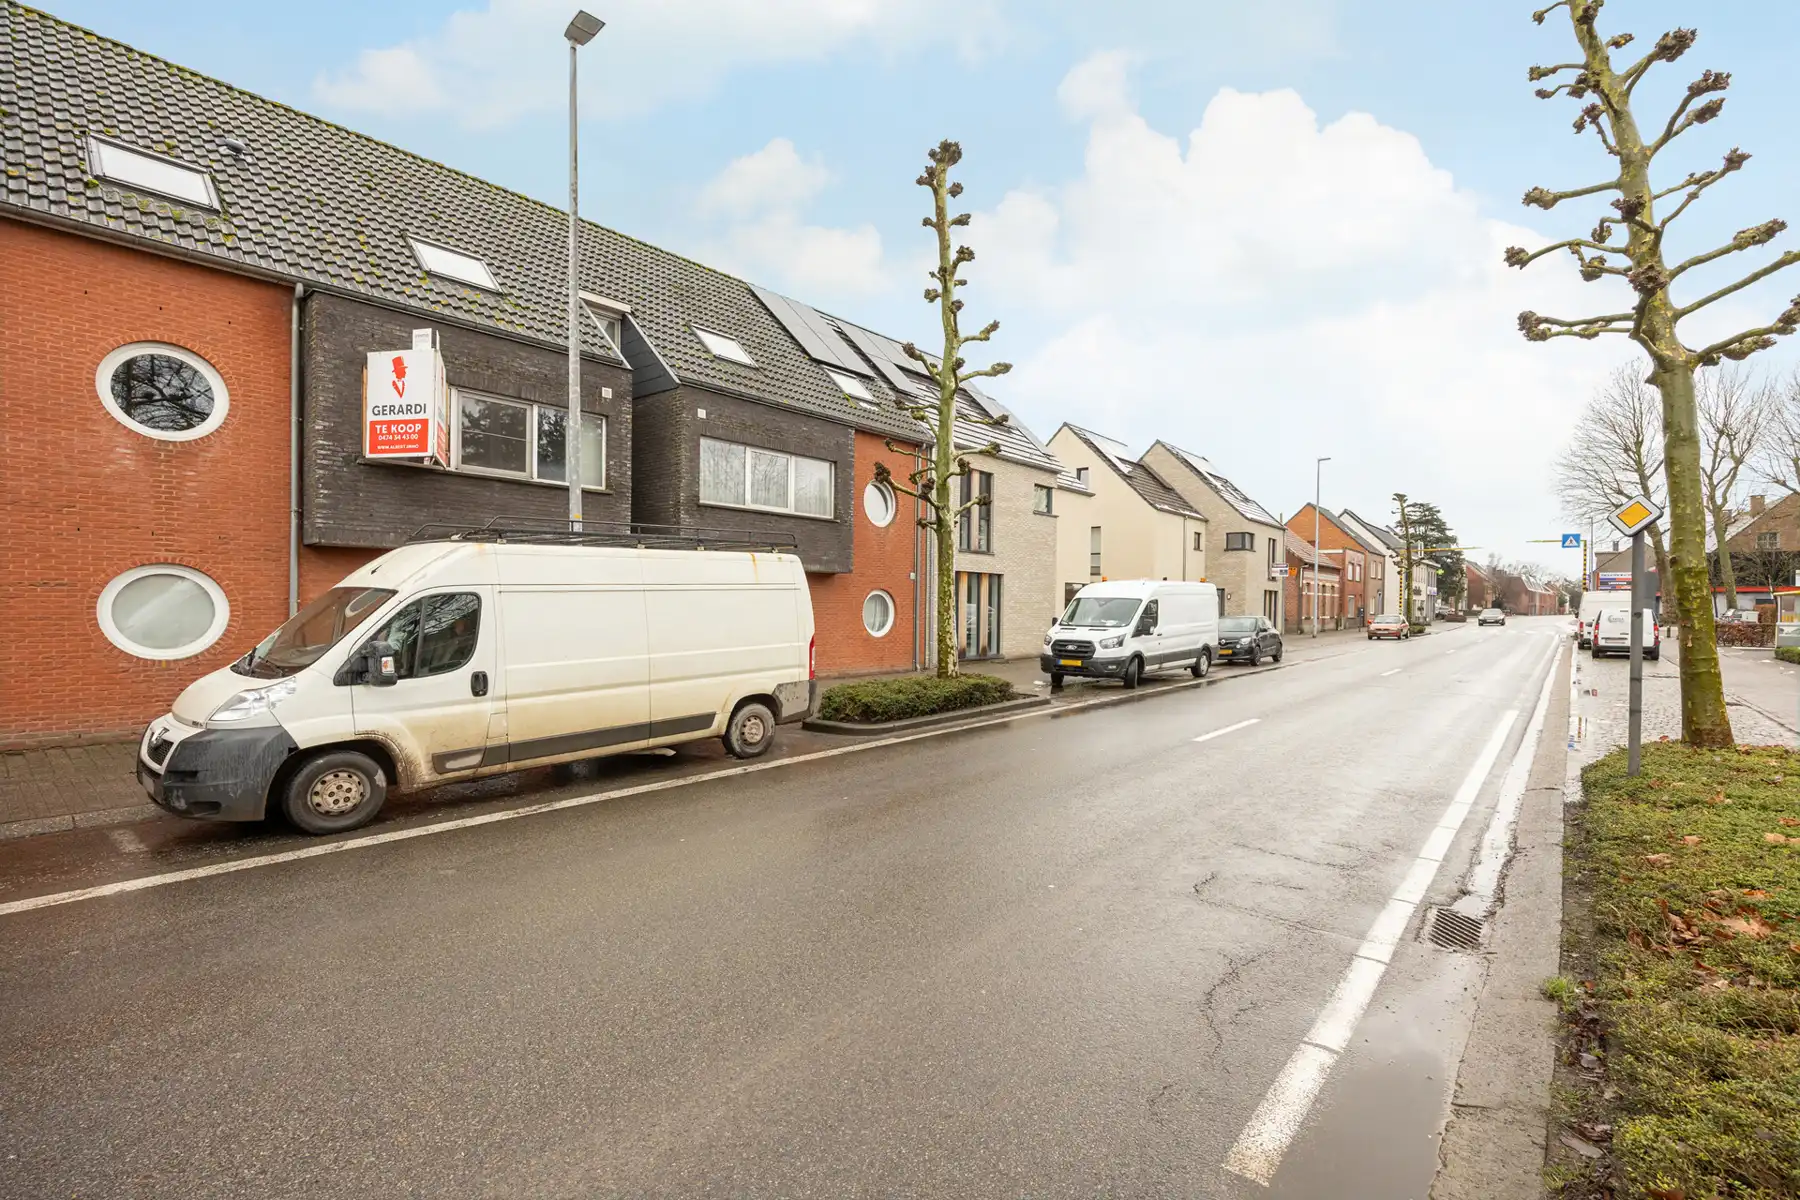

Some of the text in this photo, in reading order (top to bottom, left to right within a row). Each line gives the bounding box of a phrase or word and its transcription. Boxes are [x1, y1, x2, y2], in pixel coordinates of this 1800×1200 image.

[372, 403, 426, 416] GERARDI
[375, 423, 422, 434] TE KOOP
